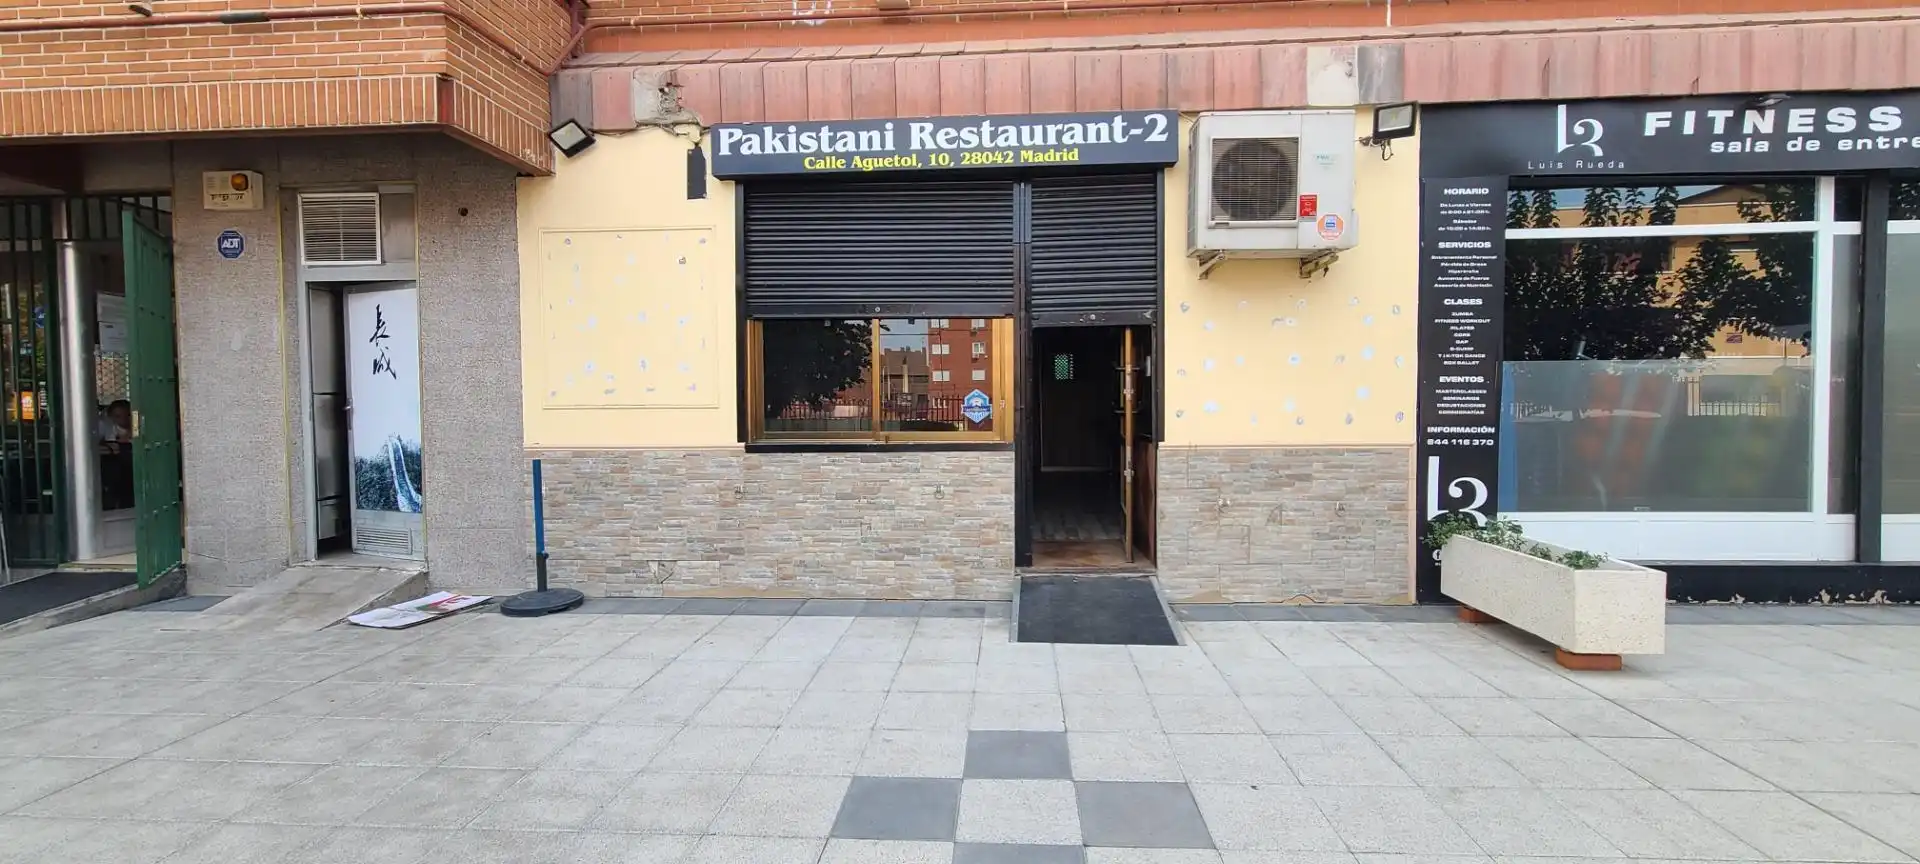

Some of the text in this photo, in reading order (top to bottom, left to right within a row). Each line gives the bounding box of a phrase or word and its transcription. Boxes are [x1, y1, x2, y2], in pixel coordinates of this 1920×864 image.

[1644, 106, 1902, 136] FITNESS
[718, 114, 1169, 155] Pakistani Restaurant-2
[1710, 138, 1770, 153] sala
[1786, 136, 1821, 151] de
[804, 148, 1080, 171] Calle Aguetol, 10, 28042 Madrid
[1528, 160, 1625, 170] Luis Rueda
[221, 239, 240, 249] ADT
